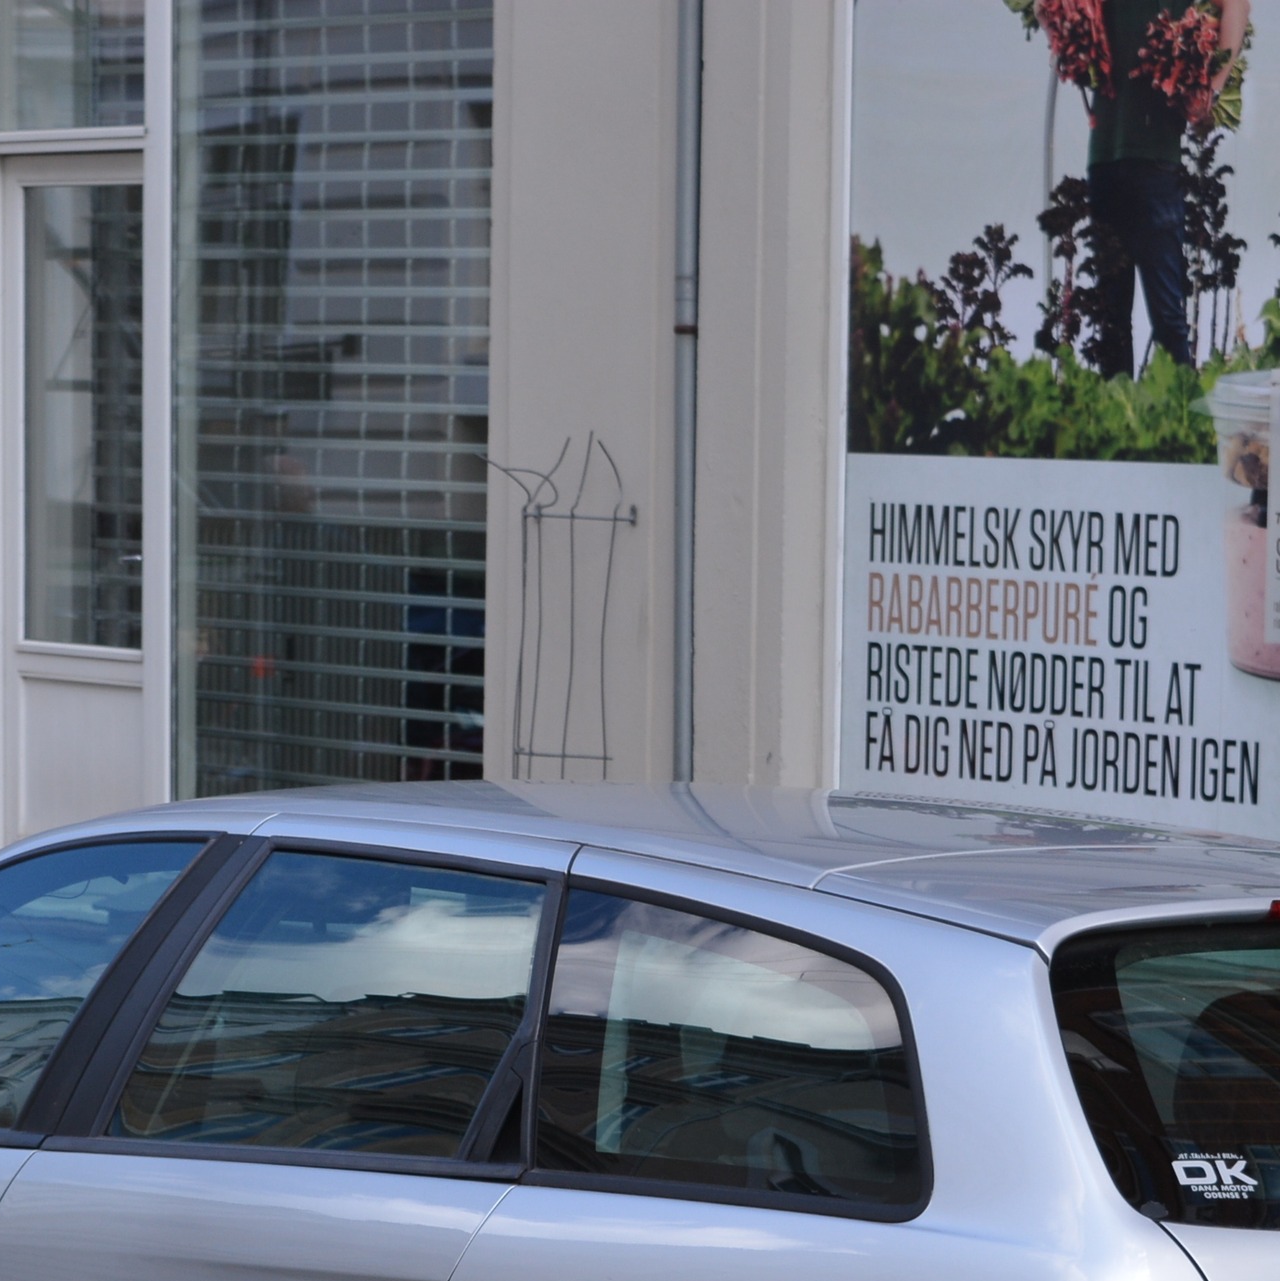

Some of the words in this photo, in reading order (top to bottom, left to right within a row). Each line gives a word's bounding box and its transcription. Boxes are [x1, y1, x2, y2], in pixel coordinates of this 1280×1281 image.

[869, 502, 1022, 570] HIMMELSK
[1028, 508, 1104, 574] SKYR
[1113, 512, 1180, 578] MED
[867, 572, 1099, 646] RABARBERPURÉ
[1108, 584, 1148, 649] OG
[866, 642, 979, 709] RISTEDE
[987, 649, 1105, 719] NØDDER
[1114, 658, 1155, 724] TIL
[1164, 661, 1202, 727] AT
[864, 707, 896, 773] FÅ
[903, 713, 949, 778] DIG
[958, 718, 1013, 783] NED
[1022, 720, 1058, 788] PÅ
[1066, 727, 1180, 799] JORDEN
[1190, 737, 1260, 805] IGEN
[1171, 1160, 1259, 1186] DK
[1191, 1184, 1219, 1193] DANA
[1220, 1184, 1255, 1193] MOTOR
[1204, 1191, 1240, 1199] ODENSE
